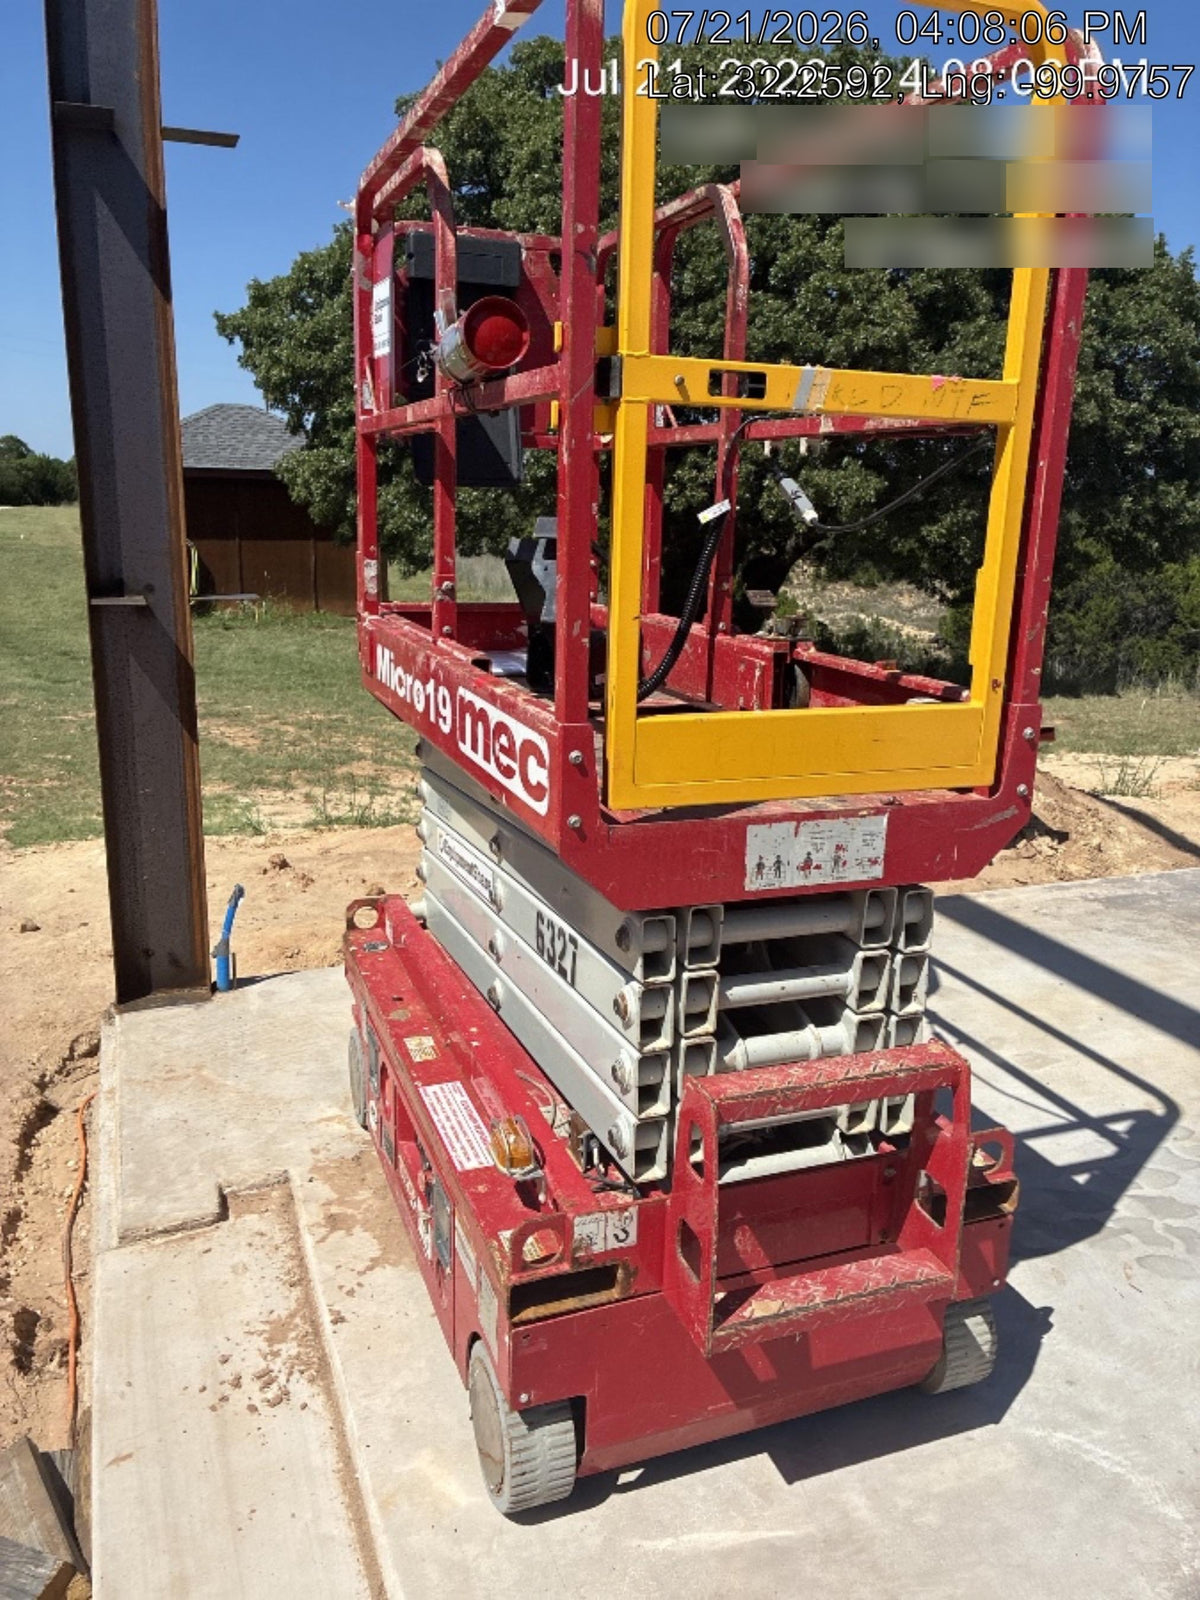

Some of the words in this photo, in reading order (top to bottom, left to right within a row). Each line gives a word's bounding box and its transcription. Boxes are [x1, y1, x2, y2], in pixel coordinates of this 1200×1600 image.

[376, 643, 452, 735] Micro19
[458, 693, 548, 803] mec
[536, 909, 579, 989] 6327
